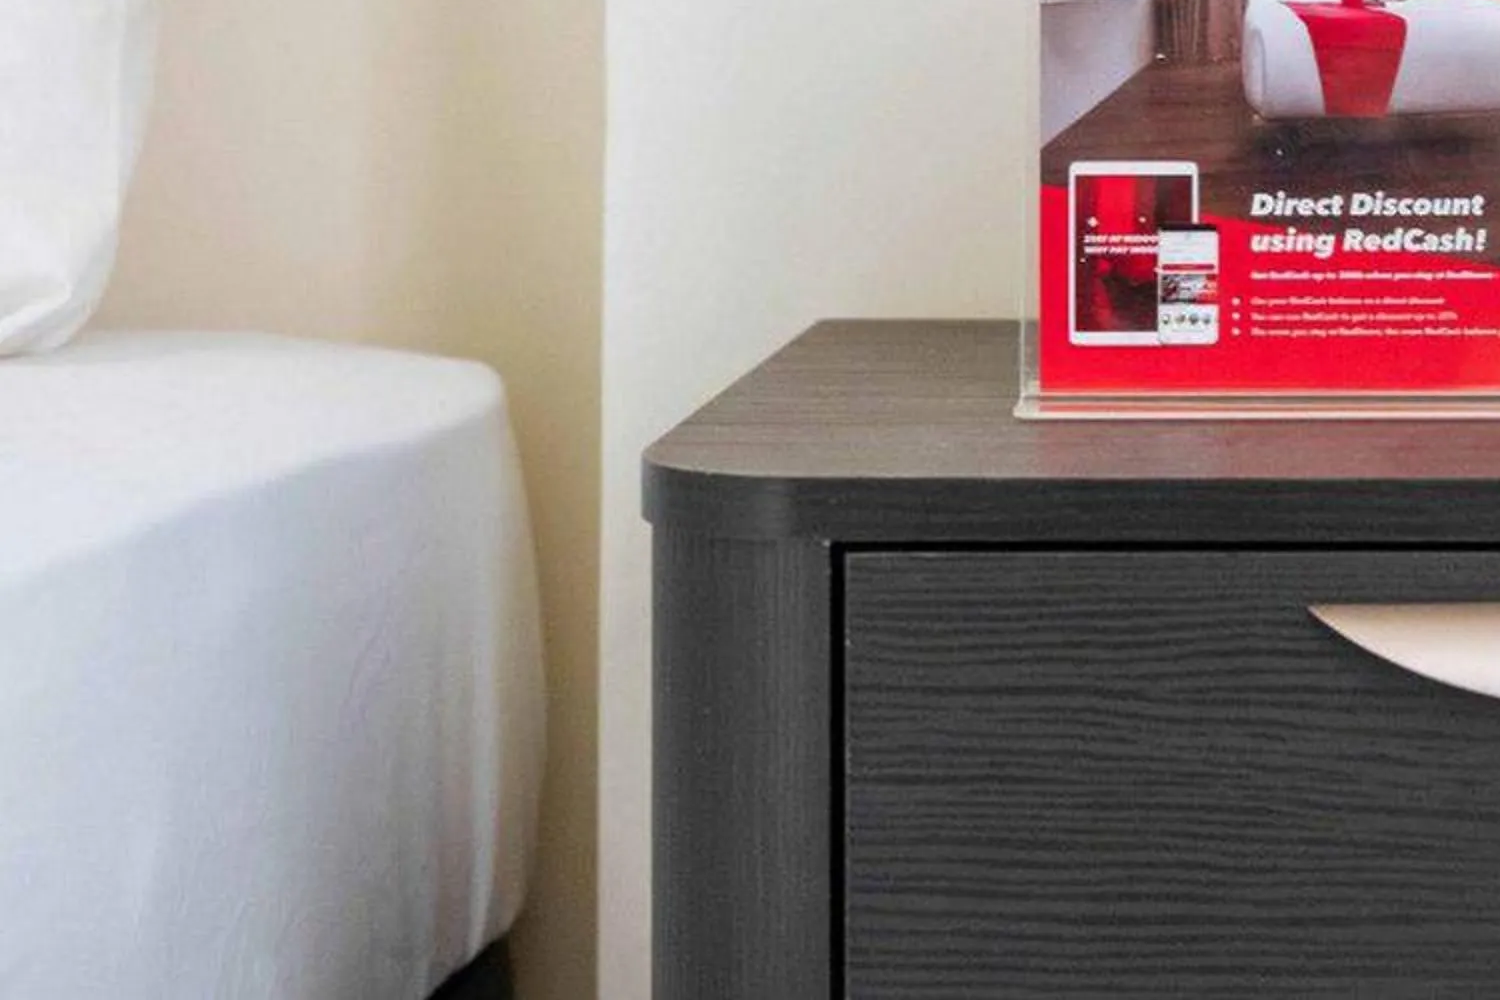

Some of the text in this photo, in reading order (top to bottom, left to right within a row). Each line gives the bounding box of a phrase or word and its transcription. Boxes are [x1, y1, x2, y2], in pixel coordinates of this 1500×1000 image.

[1250, 190, 1486, 216] Direct Discount
[1250, 226, 1488, 260] using RedCash!
